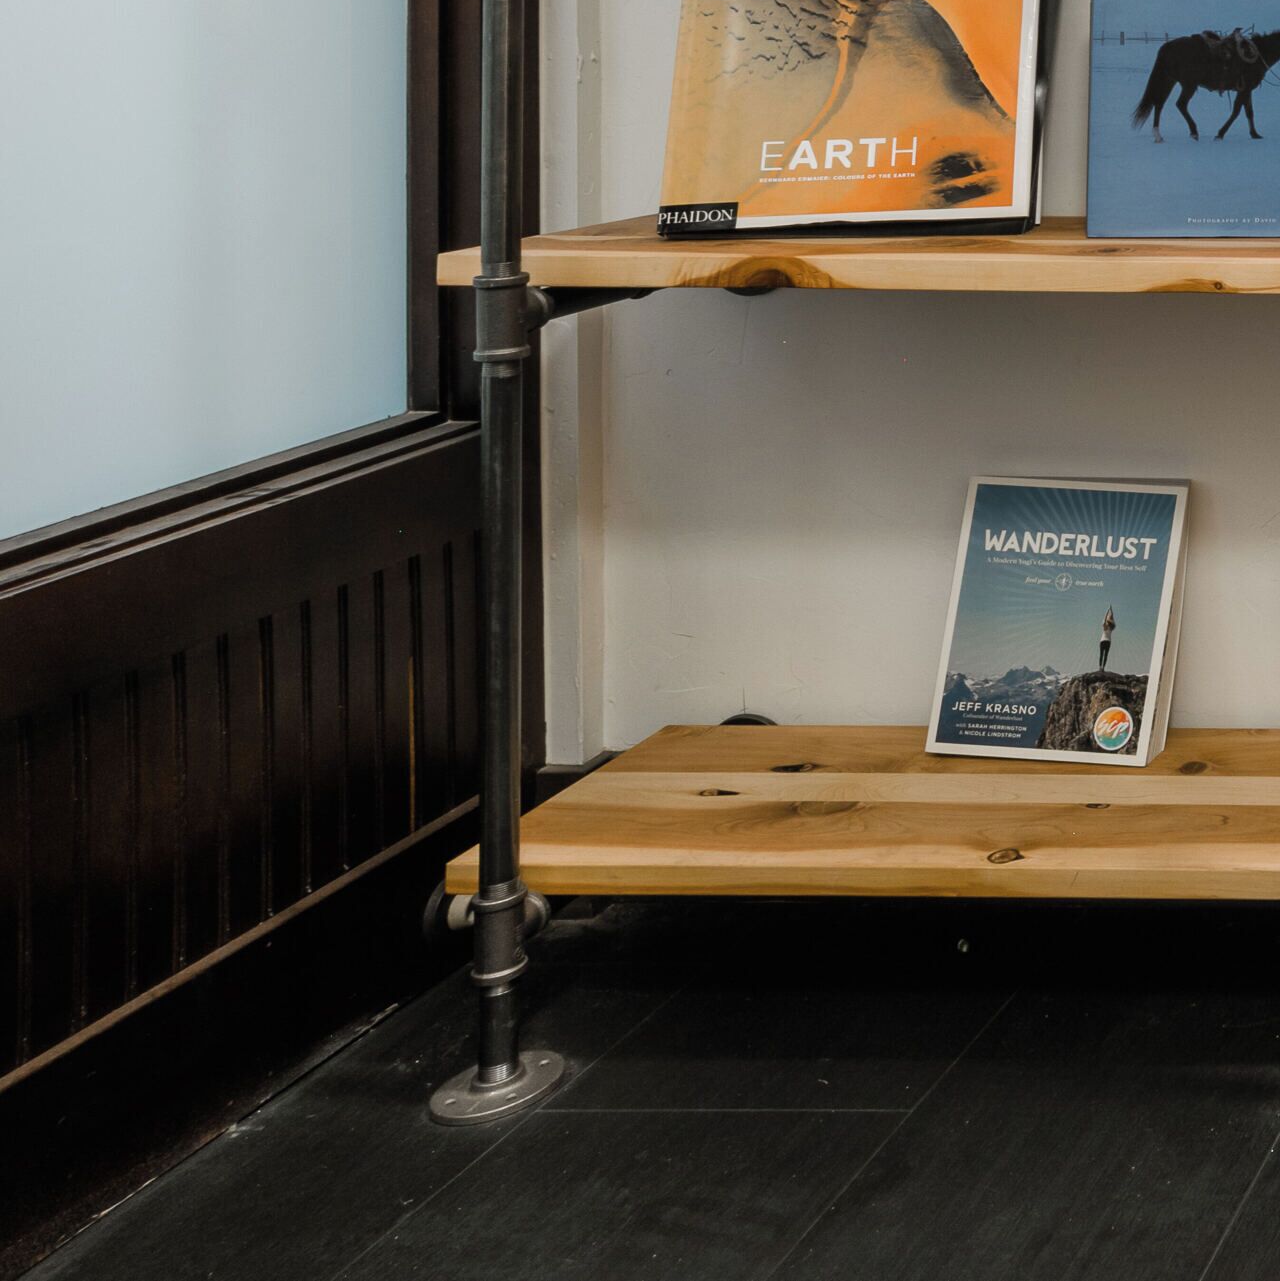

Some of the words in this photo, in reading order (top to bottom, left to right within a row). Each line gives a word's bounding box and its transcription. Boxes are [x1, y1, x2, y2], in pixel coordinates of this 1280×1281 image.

[760, 136, 918, 171] EARTH
[657, 207, 734, 226] PHAIDON
[984, 529, 1157, 560] WANDERLUST
[952, 701, 982, 712] JEFF
[985, 704, 1037, 715] KRASNO
